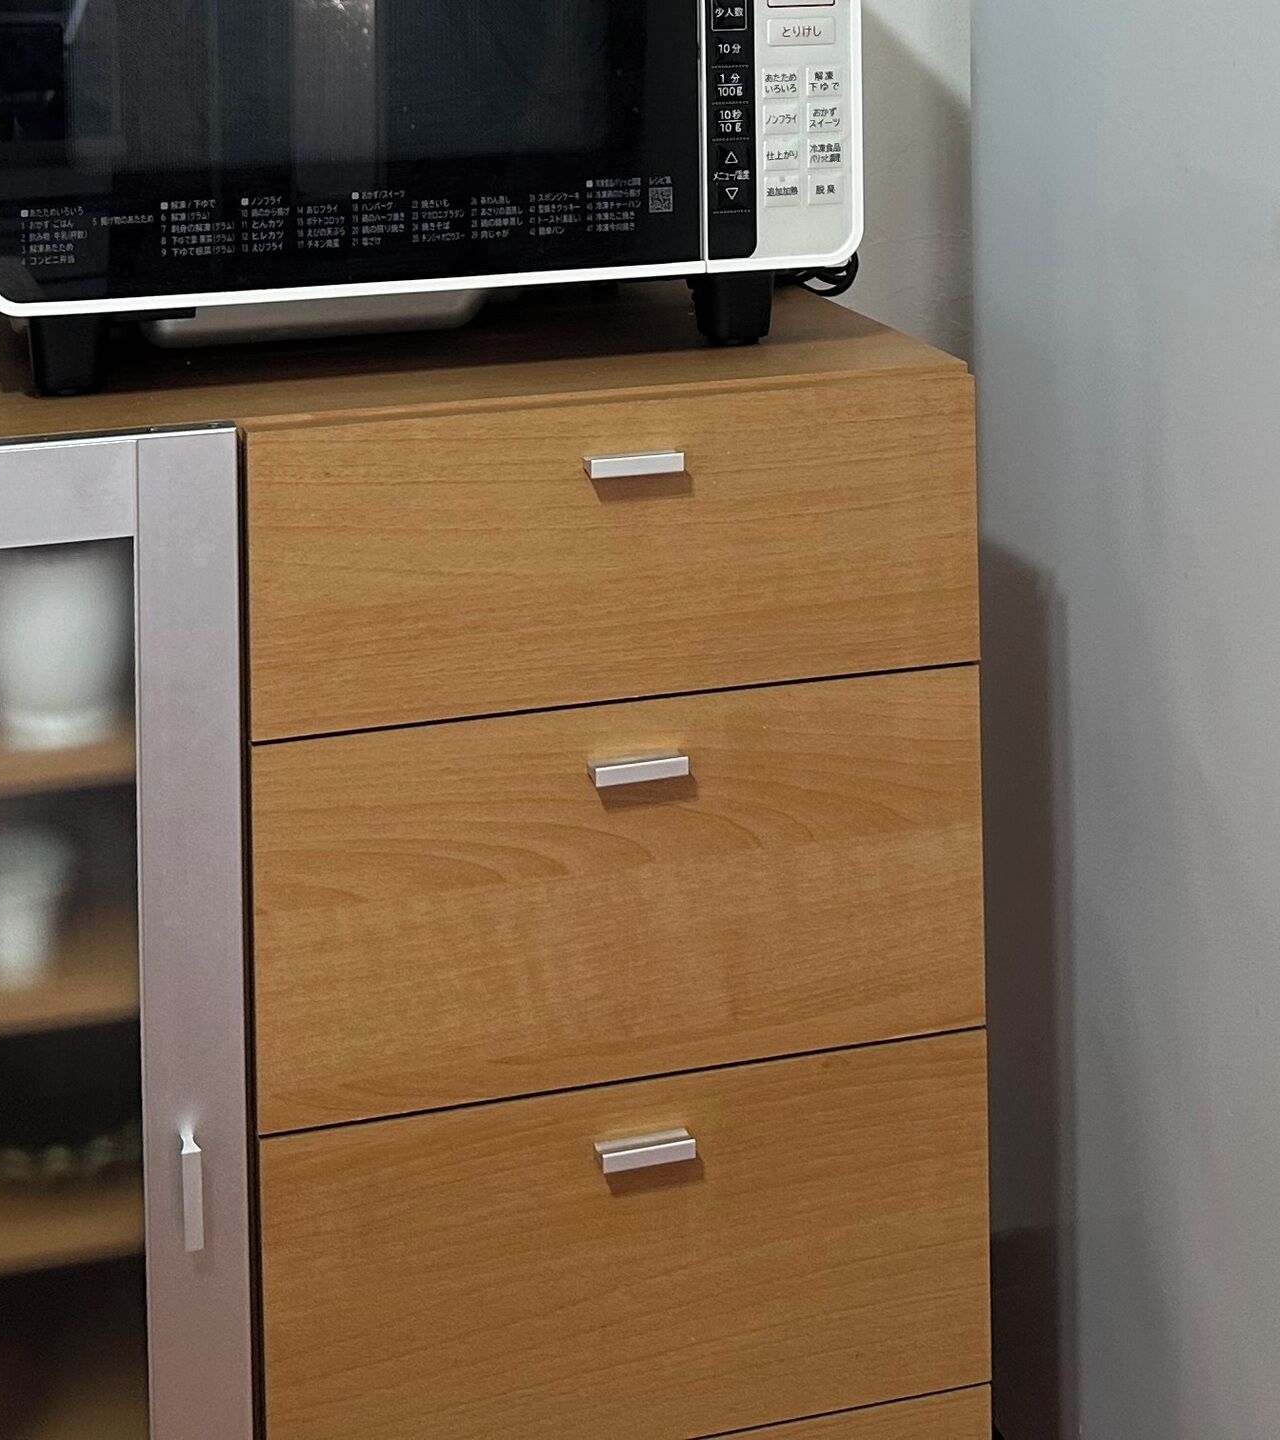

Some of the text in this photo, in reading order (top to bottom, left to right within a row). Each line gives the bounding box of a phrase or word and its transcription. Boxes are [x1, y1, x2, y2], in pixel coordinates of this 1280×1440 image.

[715, 7, 743, 18] 少人数
[782, 26, 822, 38] とりけし
[765, 73, 797, 83] あたため
[814, 71, 834, 81] 解凍
[717, 87, 743, 97] 100g
[765, 84, 797, 94] いろいろ
[809, 82, 840, 92] 下ゆで
[720, 109, 742, 120] 10秒
[812, 107, 837, 117] おかず
[765, 114, 797, 125] ノンフライ
[809, 118, 840, 128] スイーツ
[809, 143, 841, 153] 冷凍食品
[766, 151, 798, 162] 仕上がり
[767, 186, 798, 197] 追加加熱
[815, 185, 836, 195] 脱臭
[251, 196, 282, 206] ノンフライ
[538, 192, 580, 201] スポンジケーキ
[361, 201, 393, 211] ハンバーグ
[421, 199, 450, 209] 焼きいも
[595, 200, 642, 210] 冷凍チャーハン
[306, 204, 338, 215] あじフライ
[421, 209, 465, 219] マカロニグラタン
[92, 217, 97, 226] 5
[160, 214, 166, 222] 6
[306, 216, 345, 226] ポテトコロッケ
[161, 225, 166, 233] 7
[252, 219, 284, 229] とんカツ
[421, 221, 450, 231] 焼きそば
[252, 230, 284, 240] ヒレカツ
[480, 228, 510, 239] 肉じゃが
[161, 236, 167, 245] 8
[252, 242, 284, 252] えびフライ
[161, 248, 167, 257] 9
[30, 255, 75, 265] コンビニ弁当
